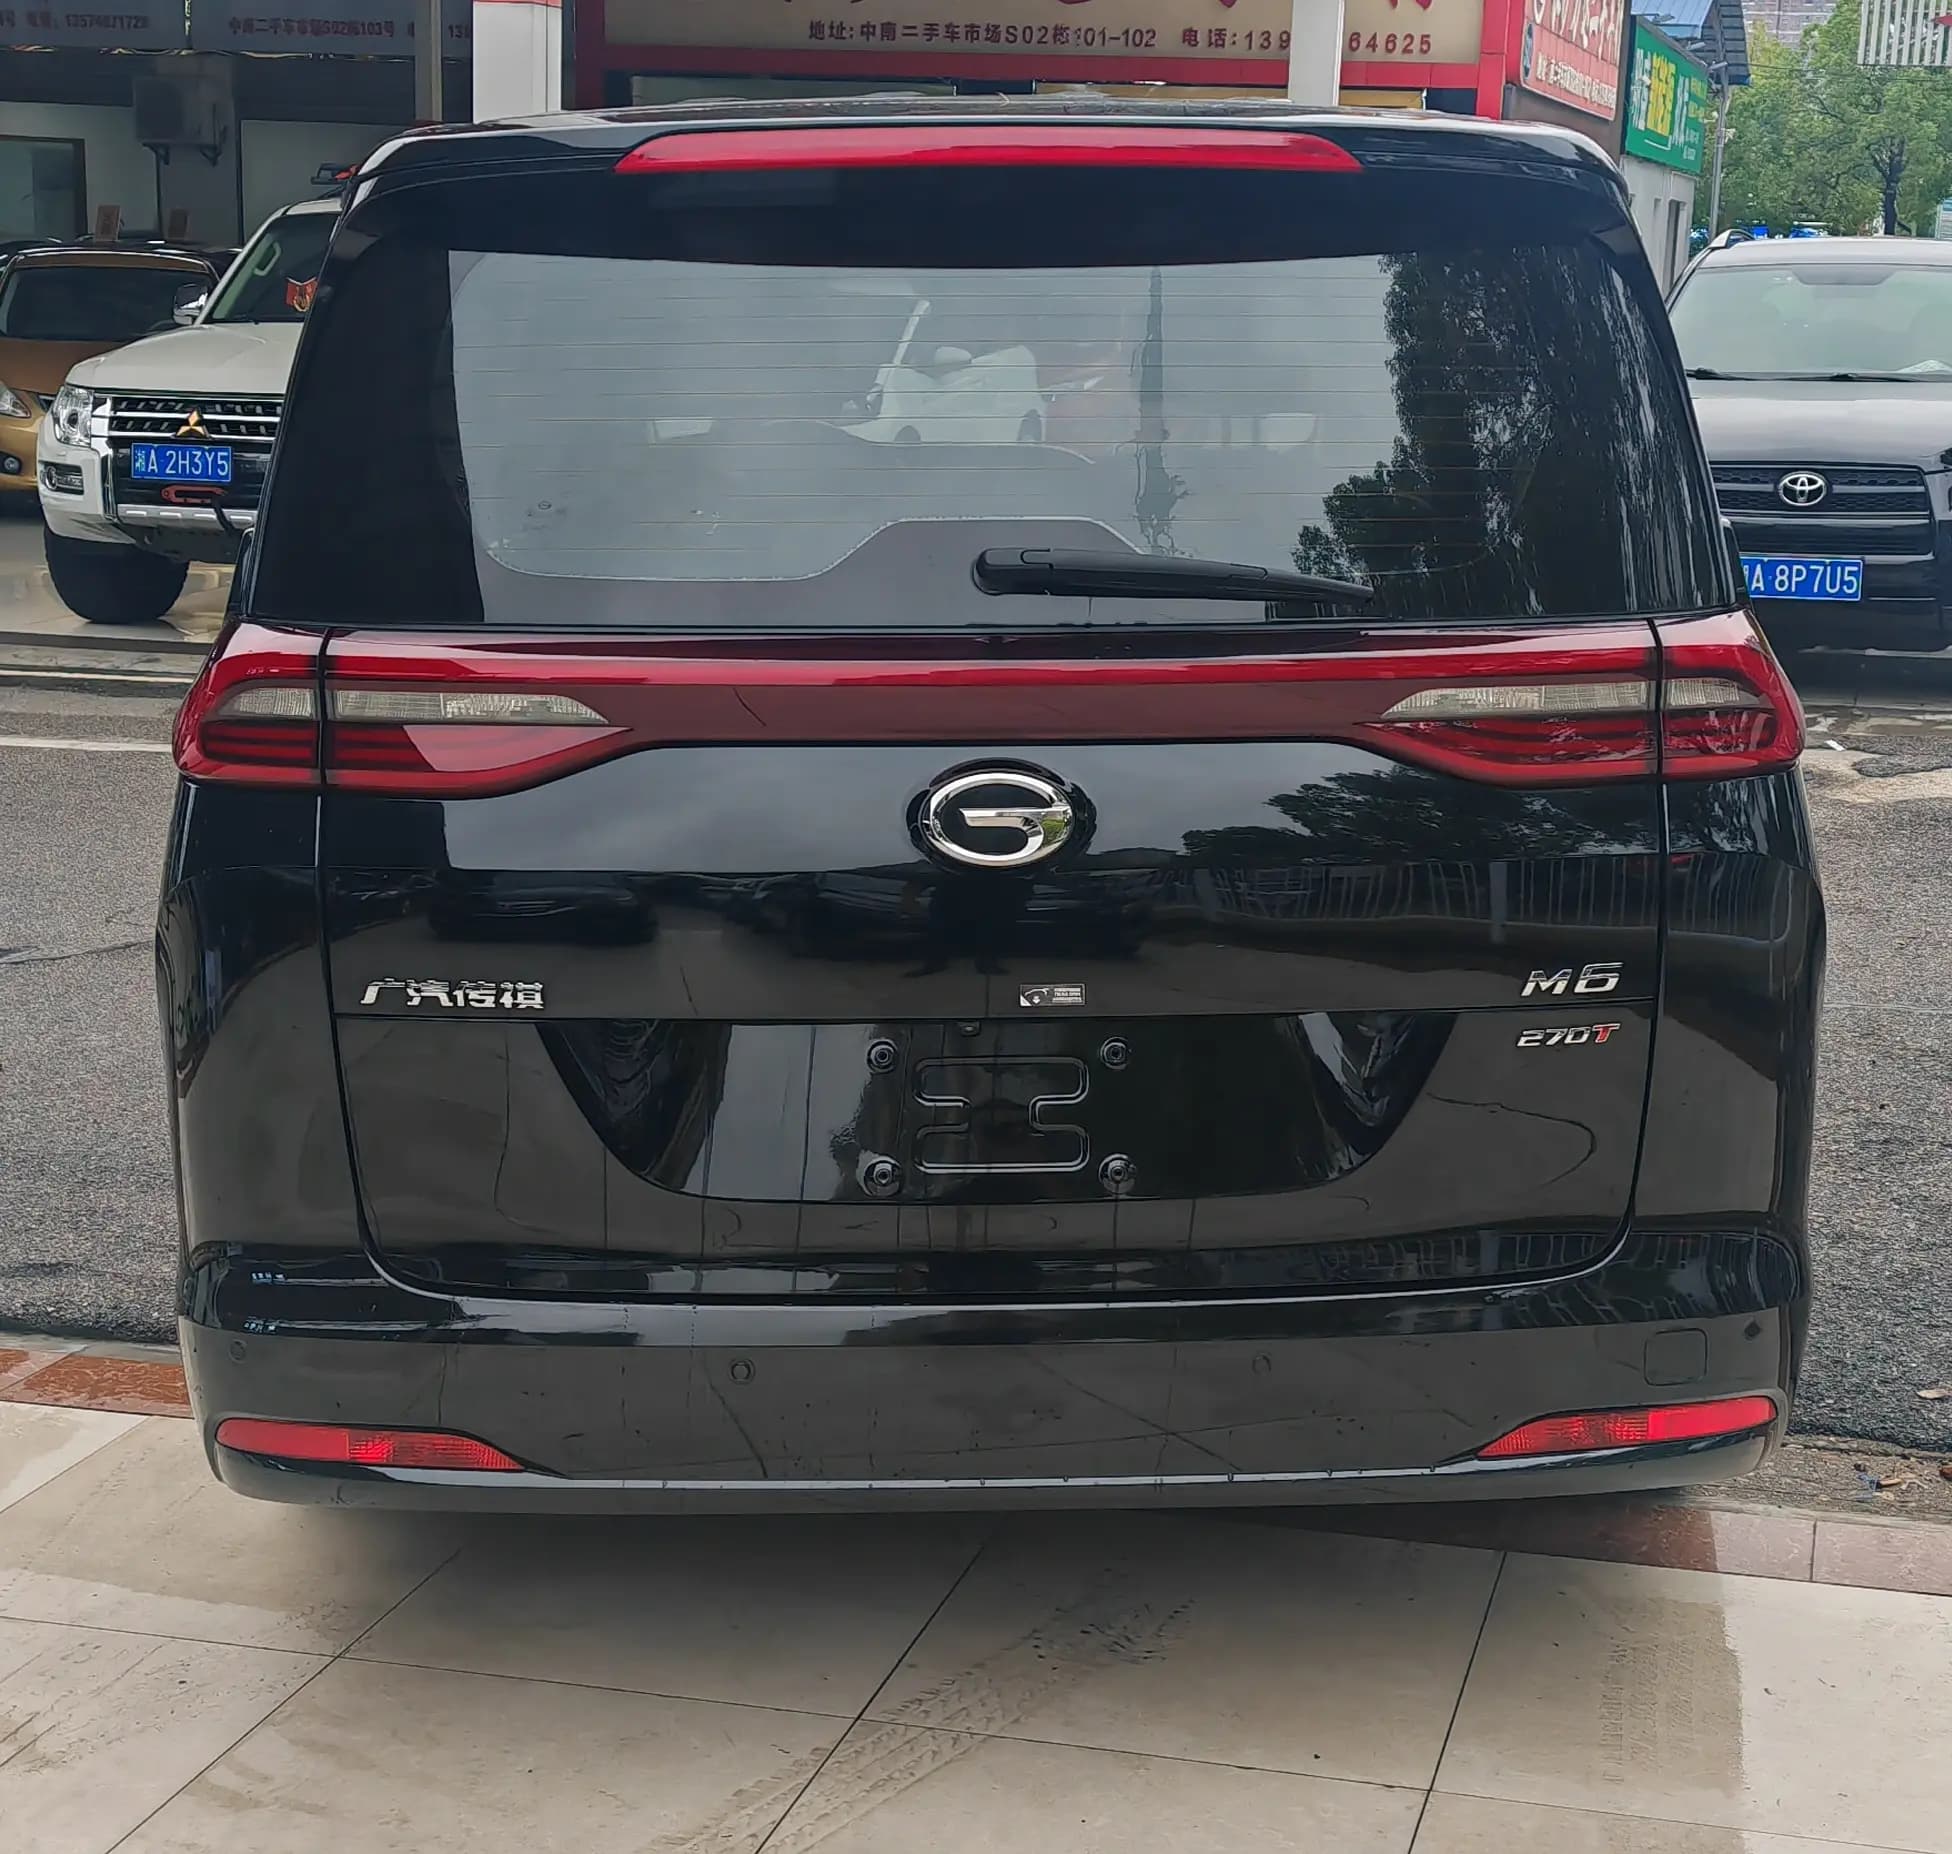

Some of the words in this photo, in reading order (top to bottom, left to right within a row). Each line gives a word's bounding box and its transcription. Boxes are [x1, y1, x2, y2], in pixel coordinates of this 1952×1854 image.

[360, 977, 545, 1009] 广汽传祺
[1520, 962, 1624, 997] M6
[1516, 1022, 1621, 1047] 270T
